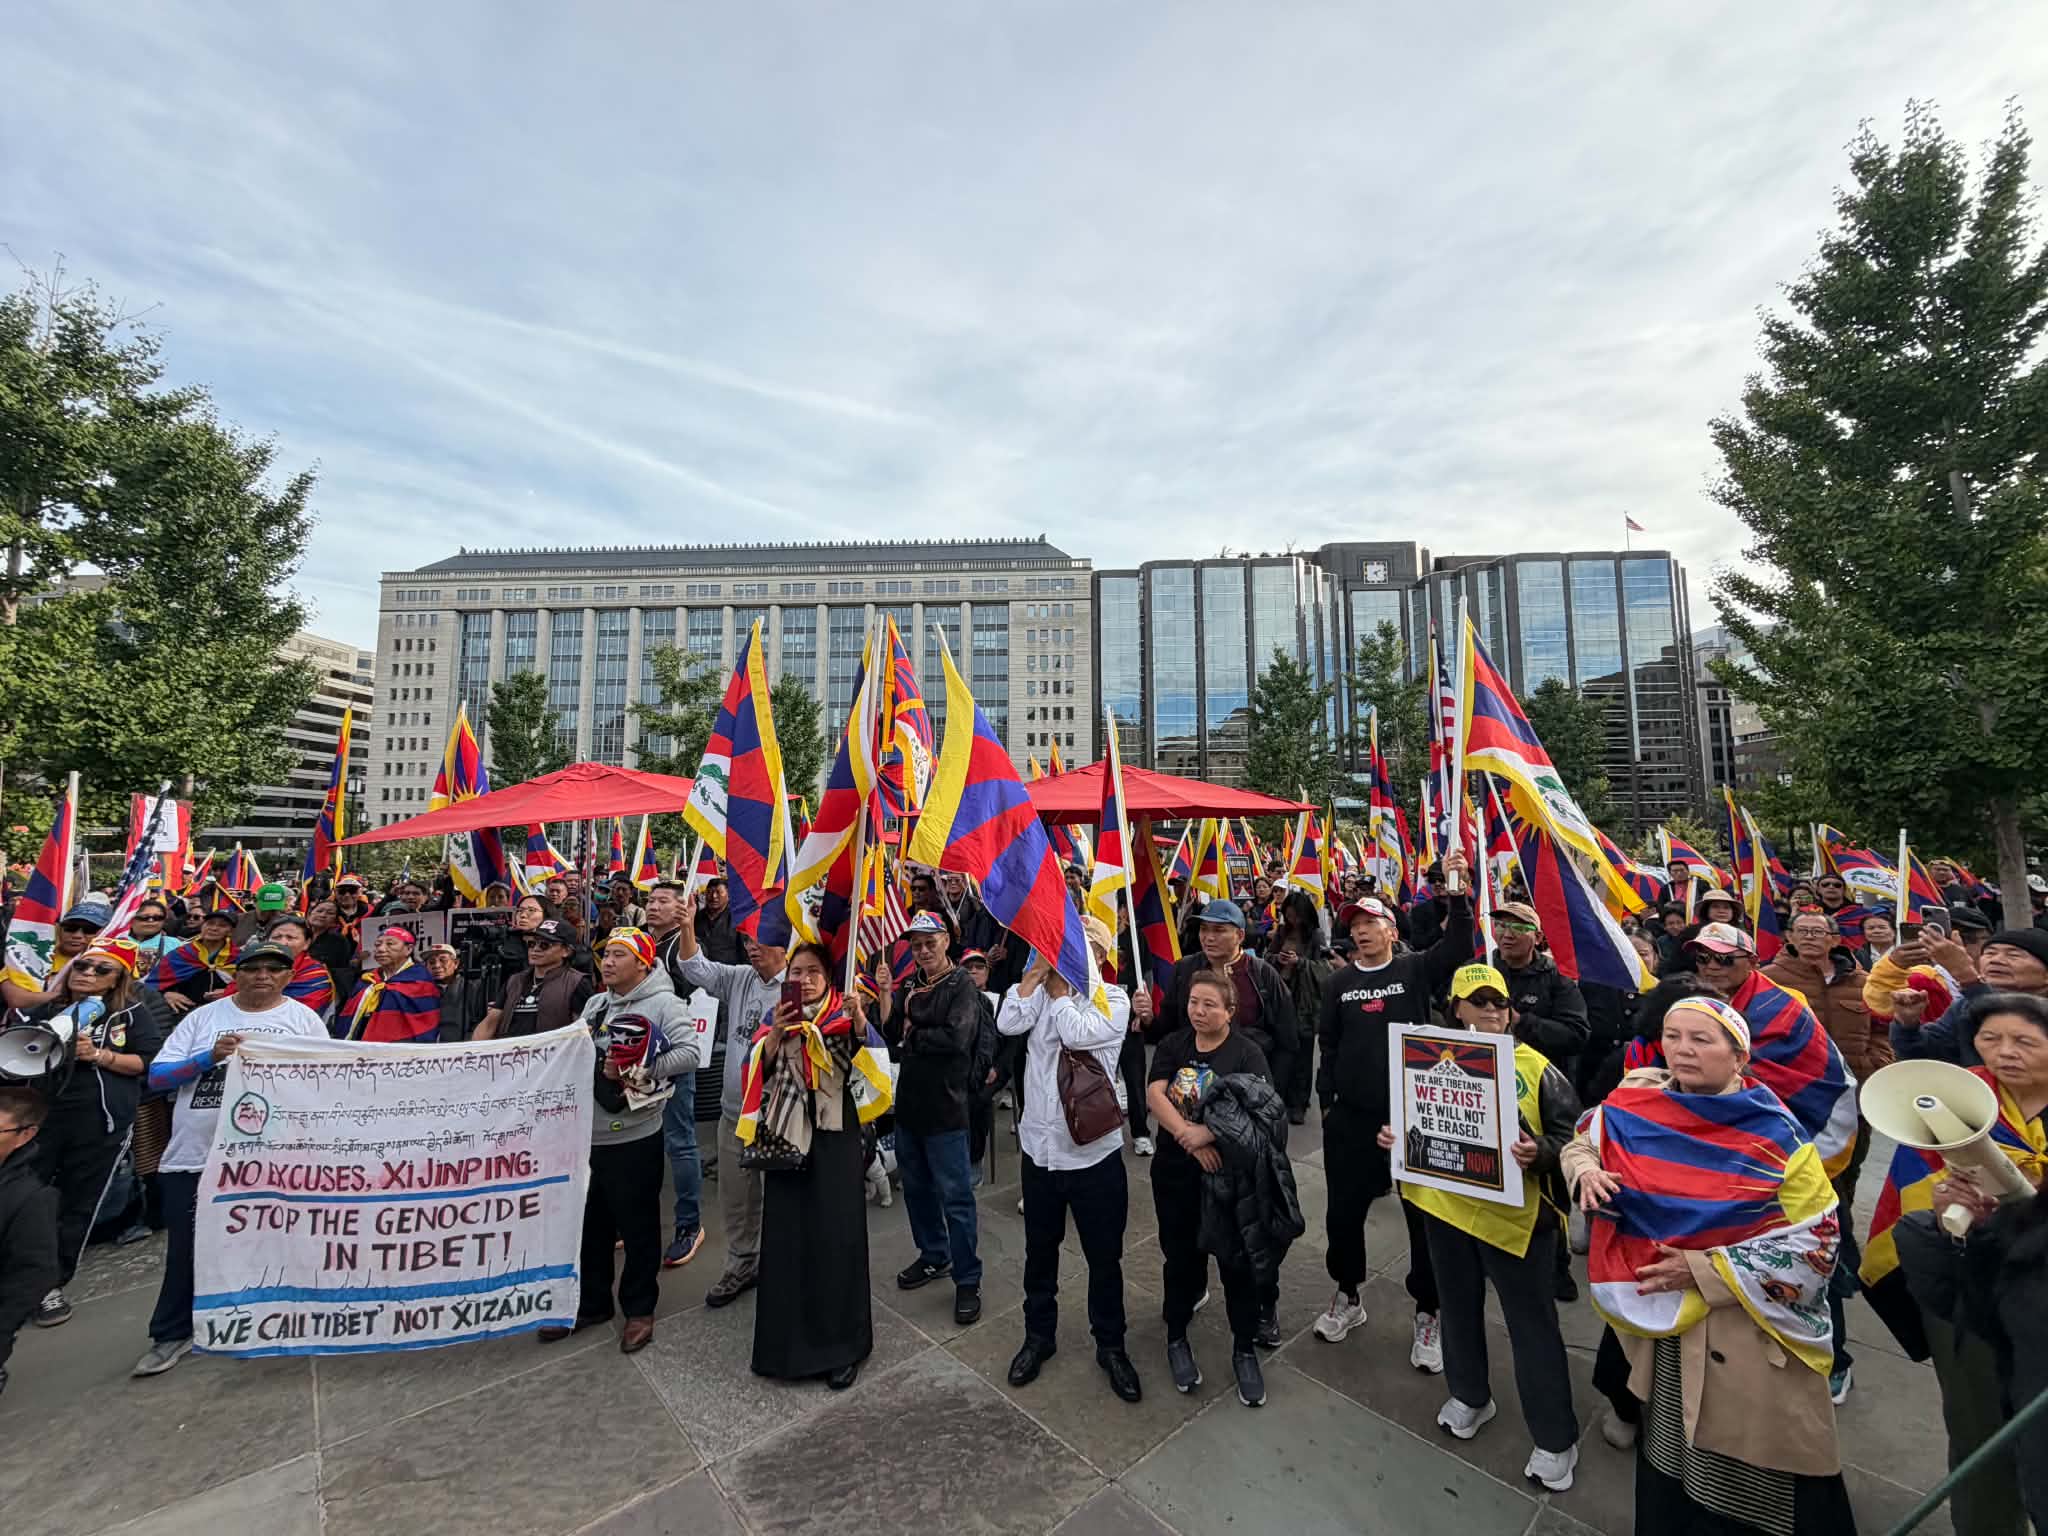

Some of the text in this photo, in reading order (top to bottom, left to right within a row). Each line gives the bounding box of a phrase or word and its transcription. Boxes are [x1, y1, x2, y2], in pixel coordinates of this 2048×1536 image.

[1340, 983, 1405, 1002] DECOLONIZE
[1414, 1073, 1426, 1084] WE
[1428, 1076, 1443, 1087] ARE
[1415, 1084, 1486, 1110] WE EXIST.
[1416, 1101, 1486, 1125] WE WILL NOT
[1421, 1116, 1483, 1140] BE ERASED.
[217, 1160, 262, 1188] NO
[226, 1192, 541, 1236] STOP THE GENOCIDE
[322, 1231, 513, 1272] IN TIBET!
[207, 1316, 253, 1346] WE
[393, 1304, 444, 1335] NOT
[450, 1290, 553, 1330] XIZANG
